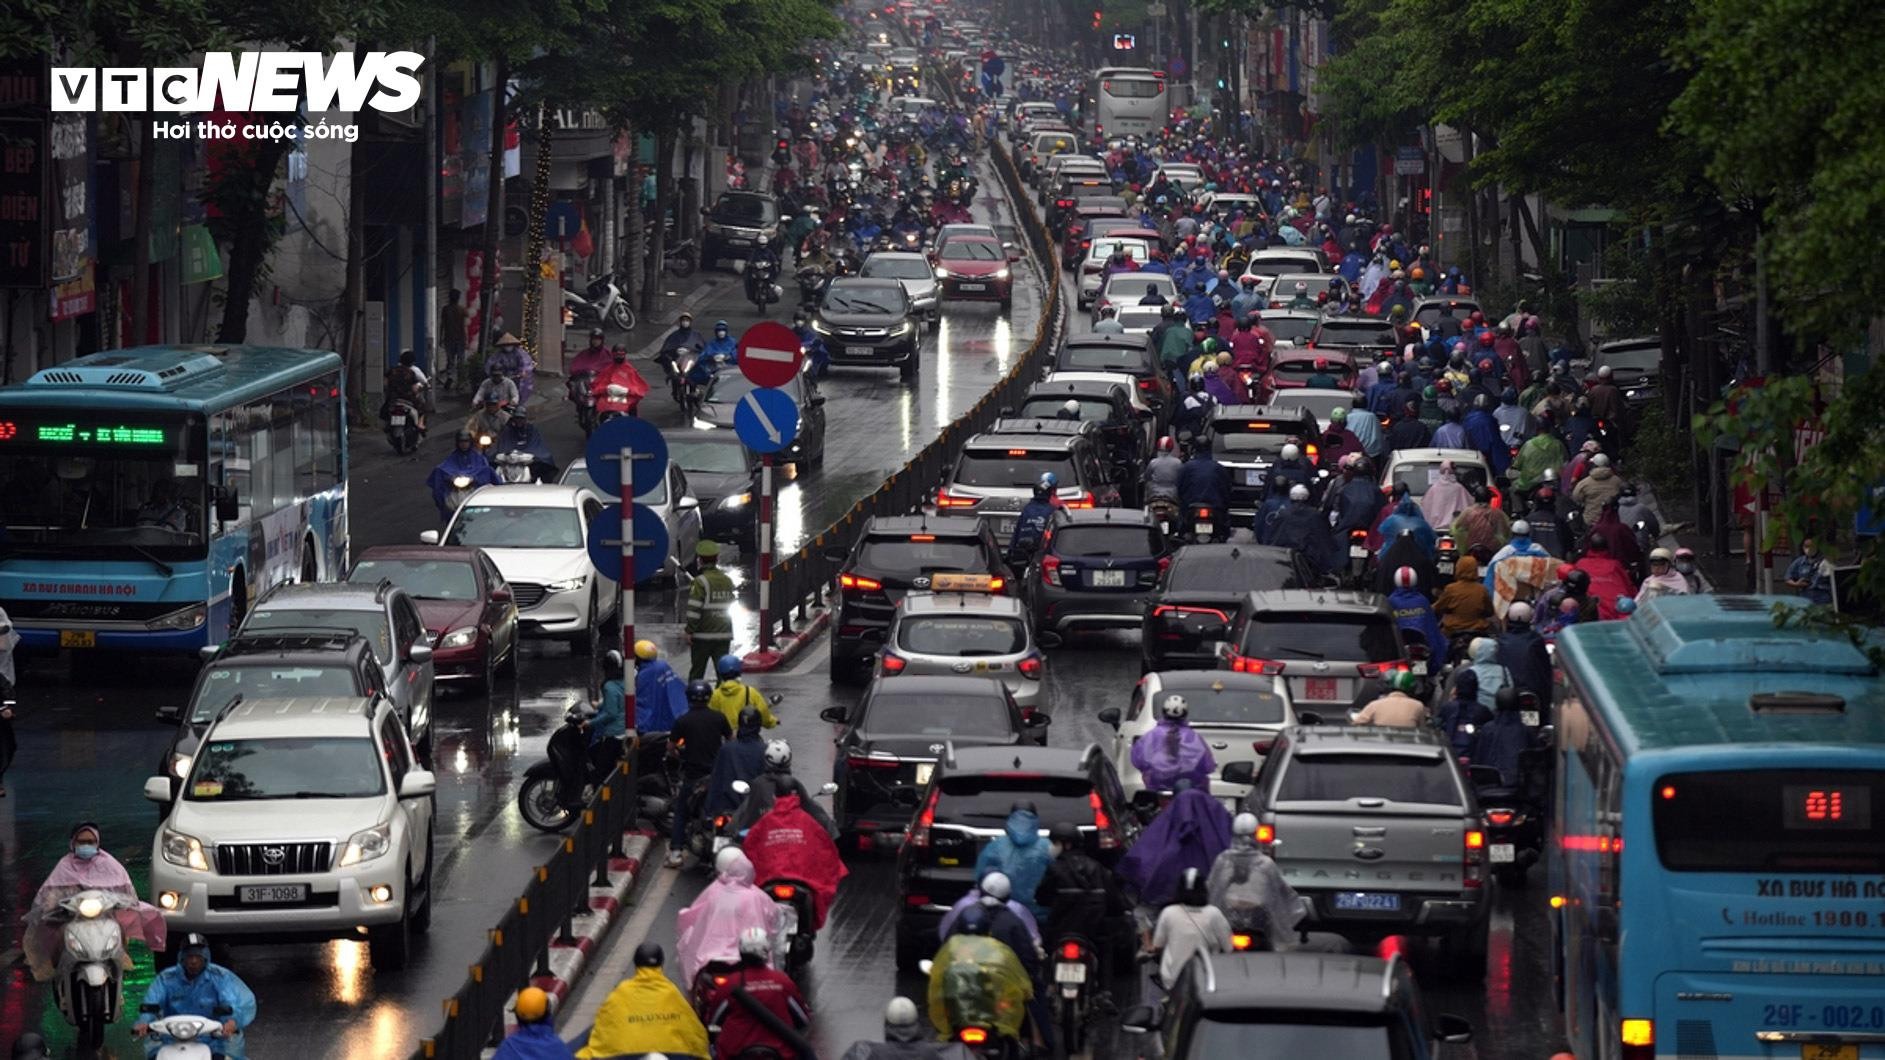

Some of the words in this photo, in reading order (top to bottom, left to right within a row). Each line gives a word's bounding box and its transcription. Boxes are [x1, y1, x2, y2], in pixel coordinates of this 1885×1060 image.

[1806, 792, 1841, 819] 01
[1281, 868, 1457, 882] RANGER
[1789, 879, 1825, 898] BUS
[1831, 876, 1857, 898] HÀ
[1743, 911, 1806, 926] Hotline
[1764, 1004, 1803, 1027] 29F
